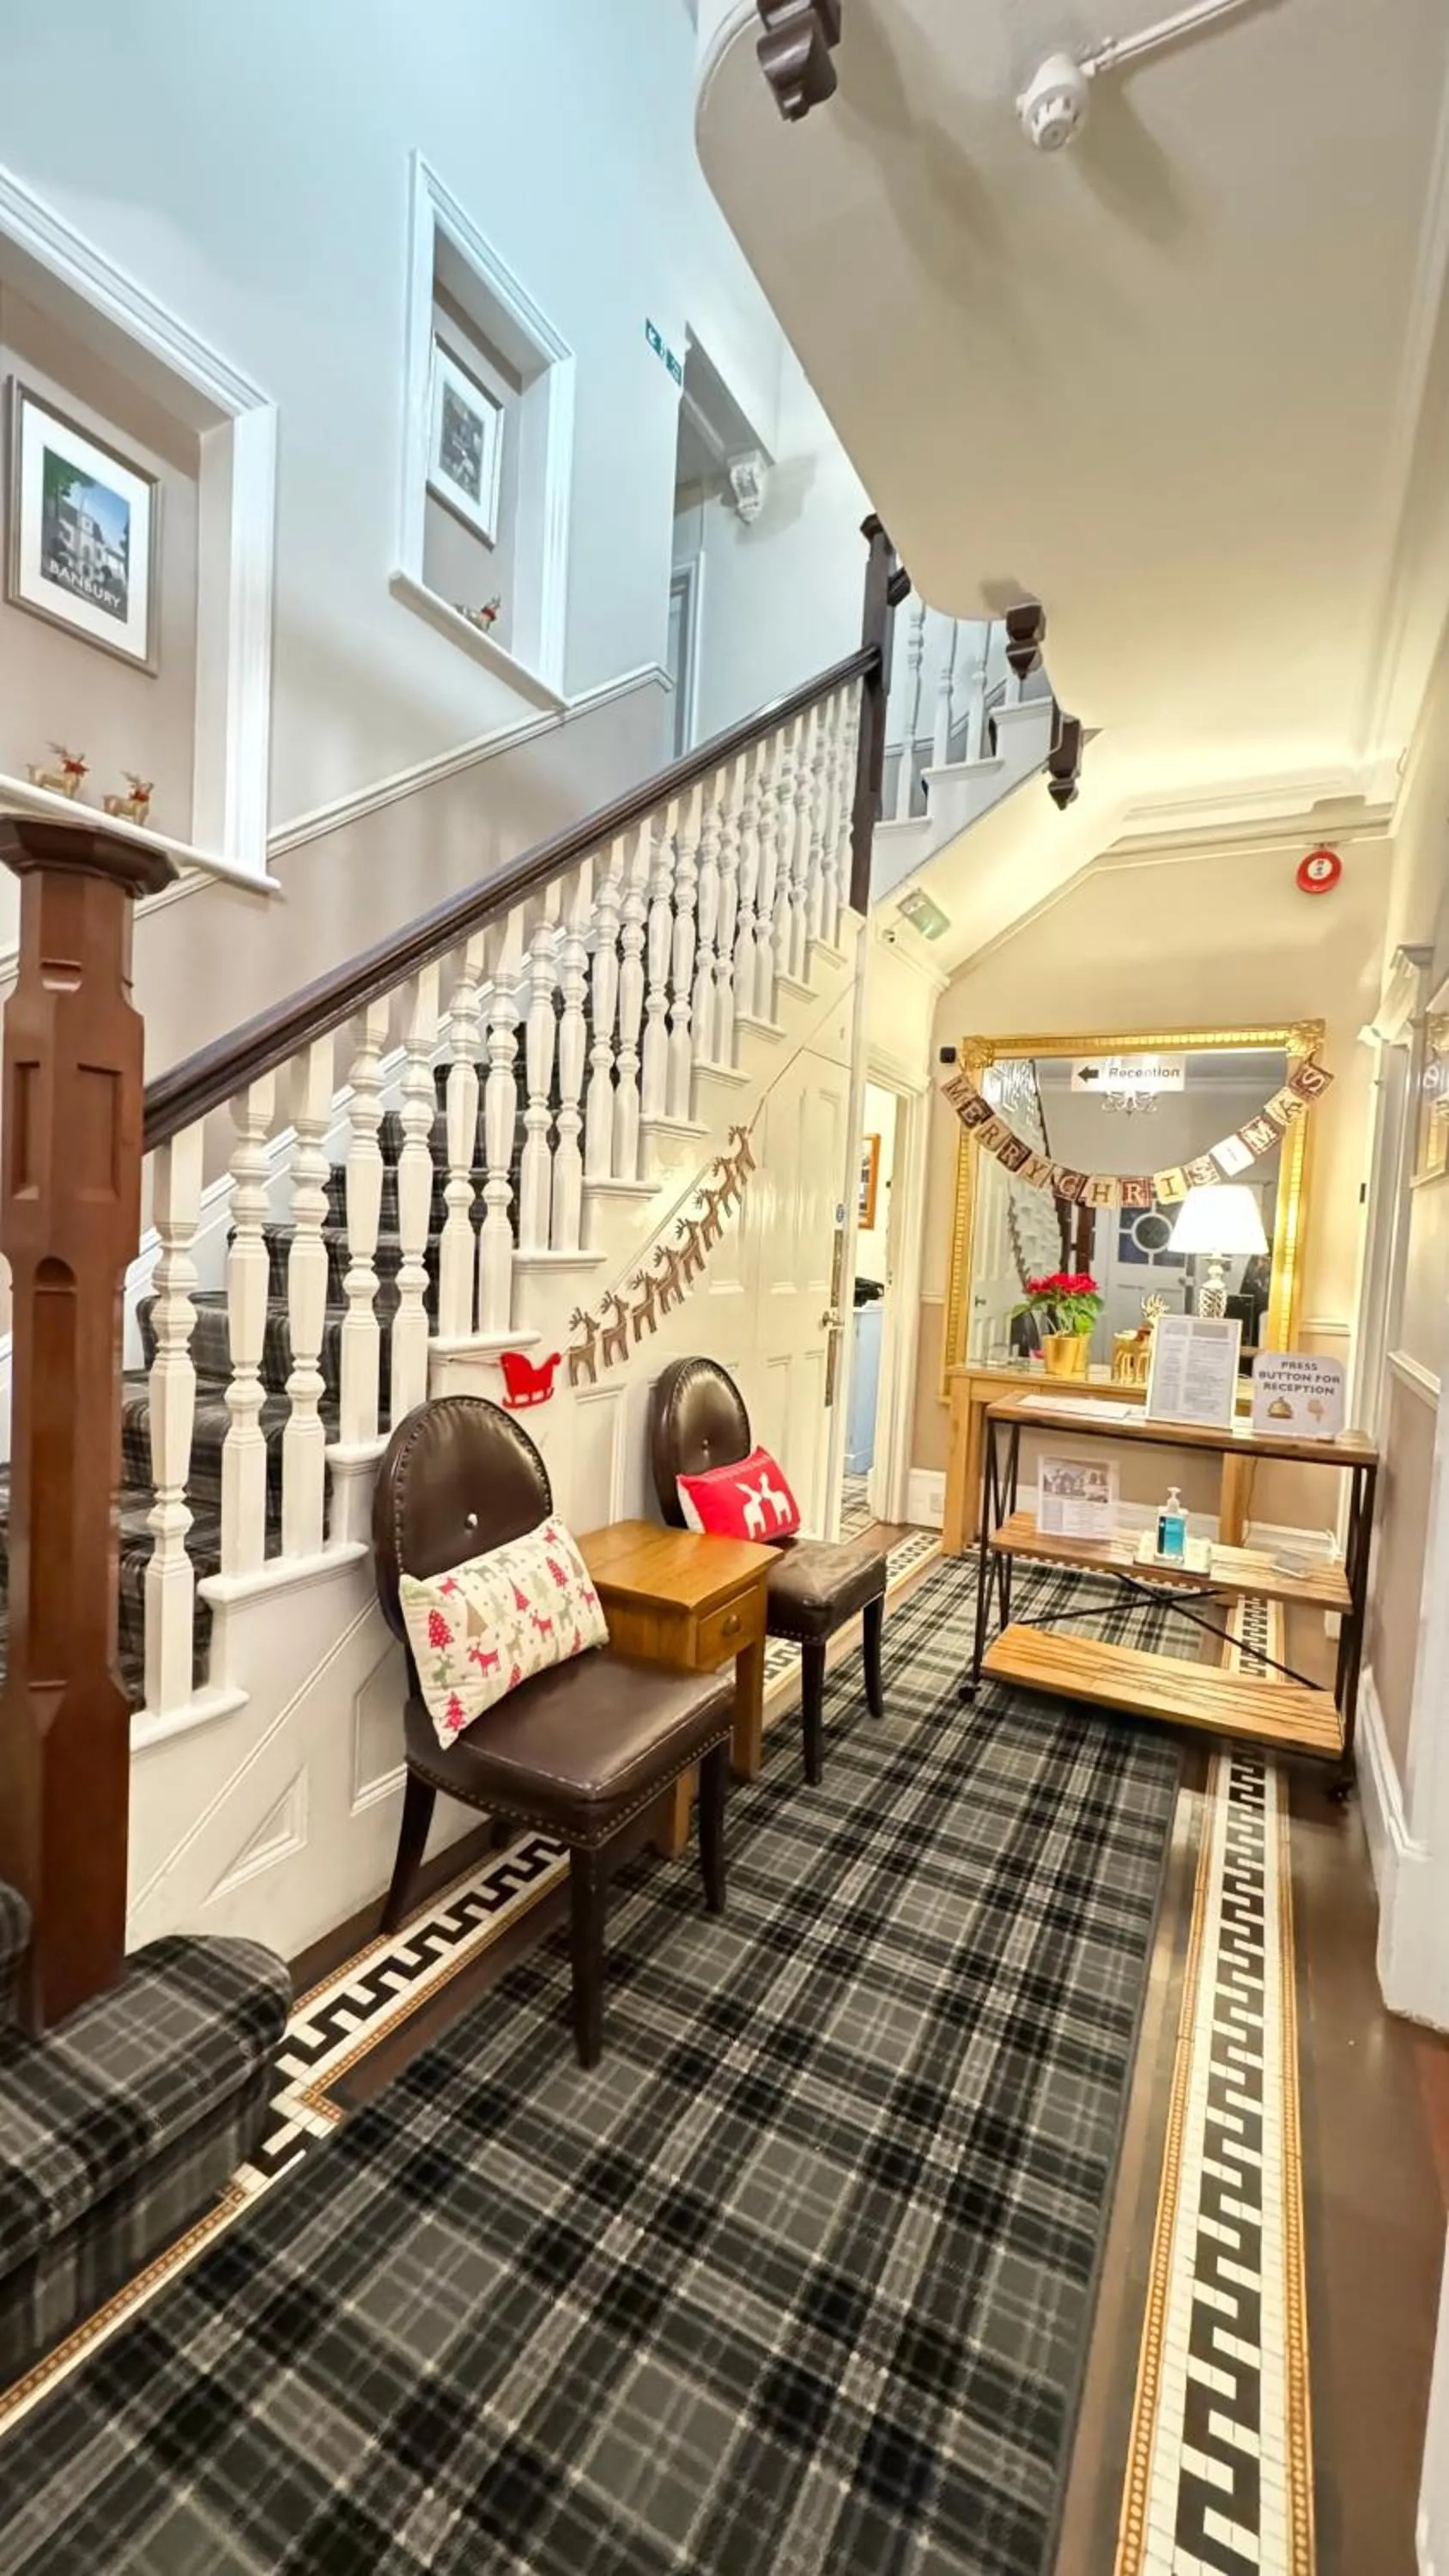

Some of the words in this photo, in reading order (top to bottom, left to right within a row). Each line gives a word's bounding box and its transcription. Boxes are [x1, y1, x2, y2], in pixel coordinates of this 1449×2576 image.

[50, 558, 121, 608] BANBURY
[1108, 1066, 1180, 1080] Reception
[946, 1078, 1047, 1180] MERRY
[1058, 1070, 1325, 1203] CHRISMAS
[1281, 1361, 1318, 1370] PRESS
[1258, 1370, 1311, 1382] BUTTON
[1315, 1374, 1340, 1383] FOR
[1263, 1382, 1335, 1394] RECEPTION
